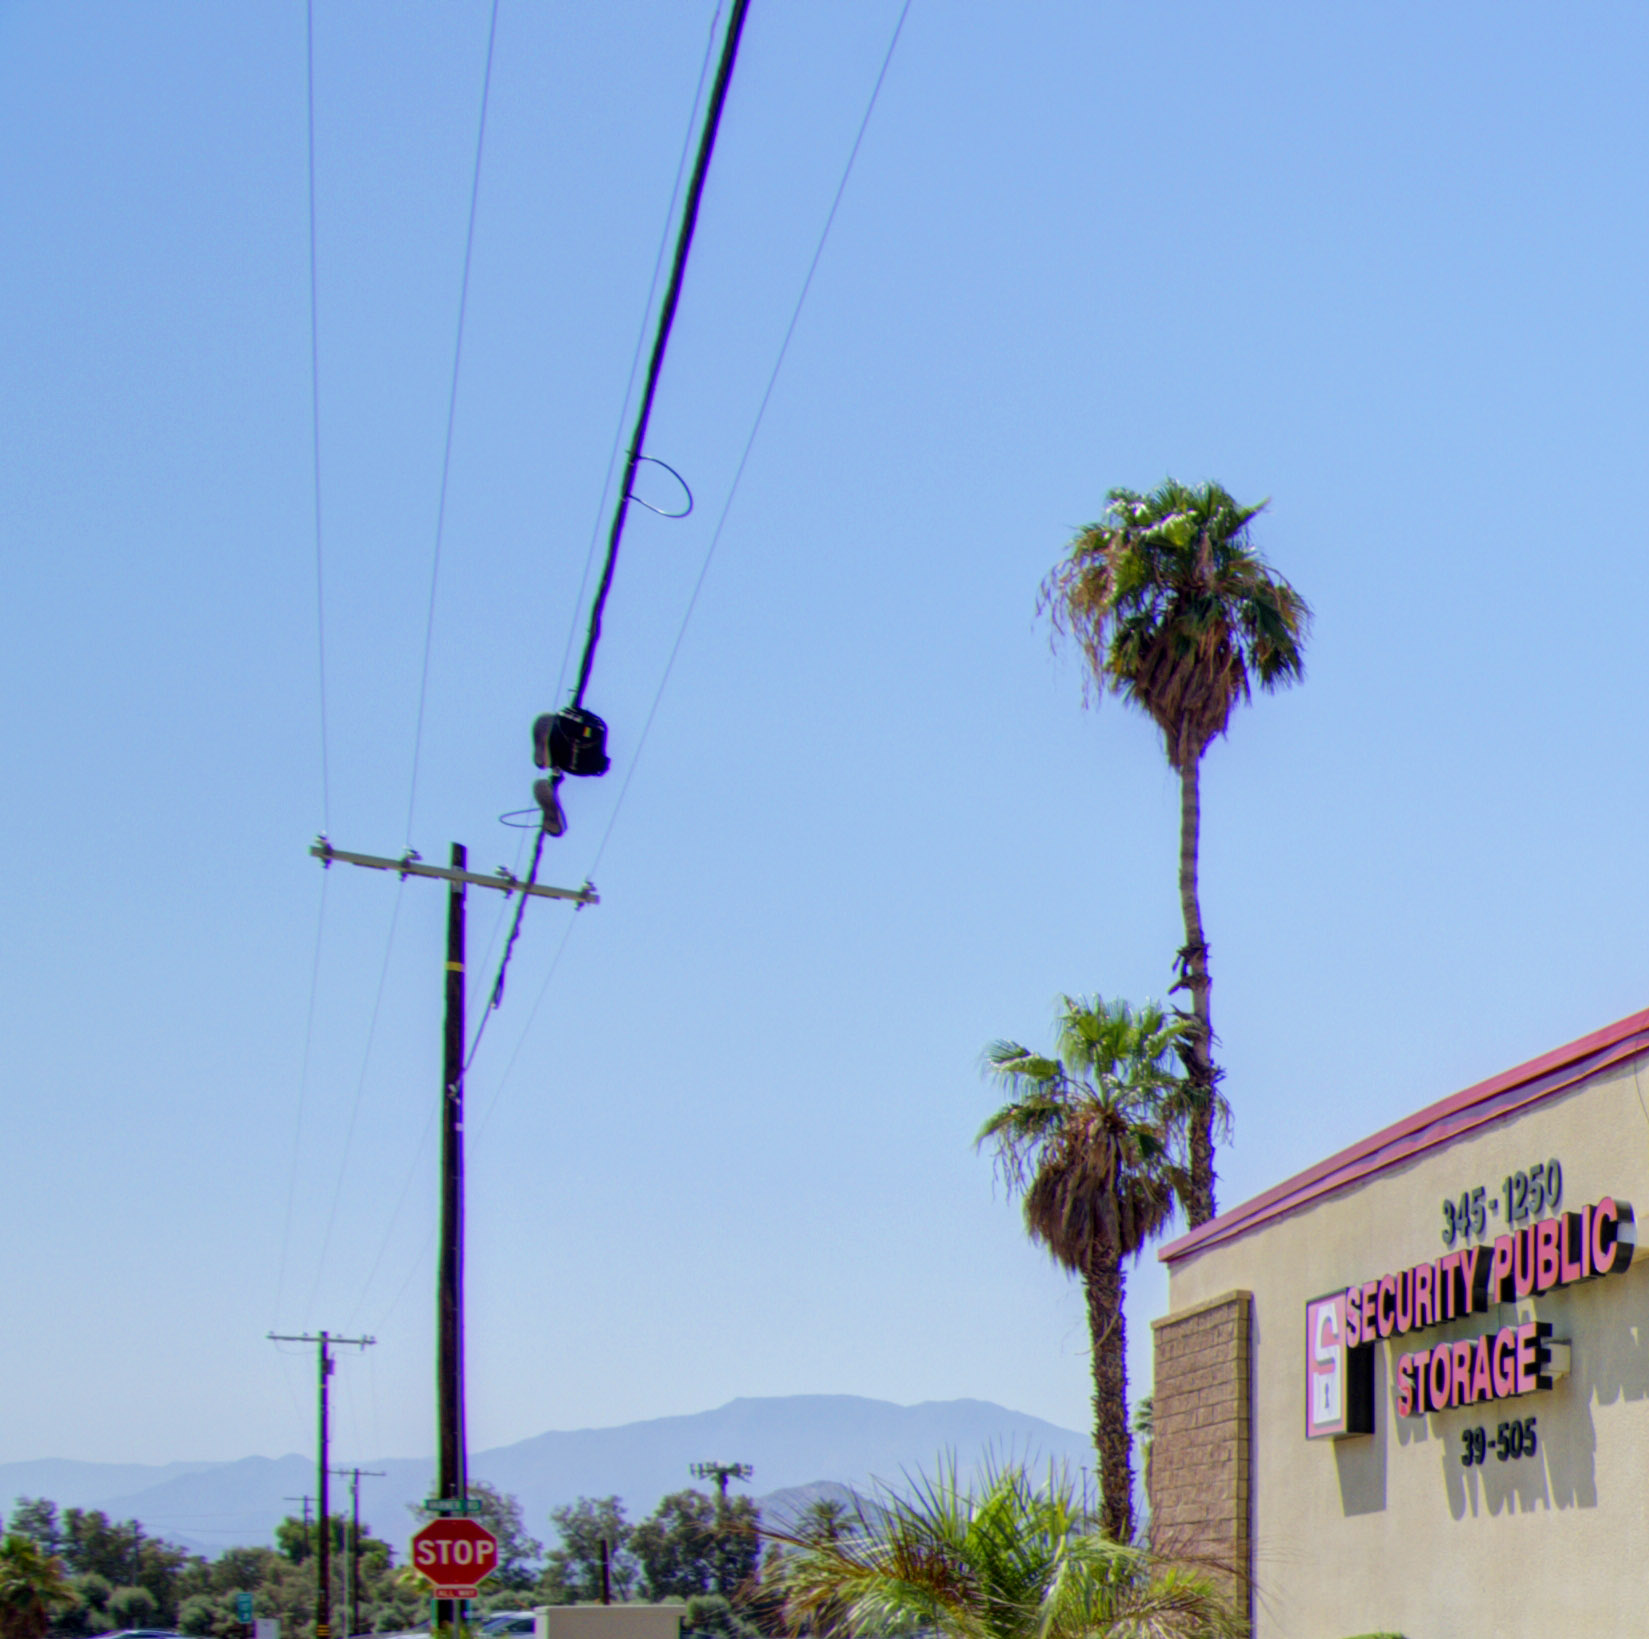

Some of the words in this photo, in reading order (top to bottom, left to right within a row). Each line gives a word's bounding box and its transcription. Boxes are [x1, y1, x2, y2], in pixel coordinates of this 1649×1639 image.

[1441, 1157, 1563, 1246] 345-1250
[1345, 1248, 1484, 1348] SECURITY
[1493, 1196, 1624, 1304] PUBLIC
[1396, 1321, 1540, 1418] STORAGE
[1460, 1416, 1538, 1466] 39-505
[417, 1540, 494, 1565] STOP
